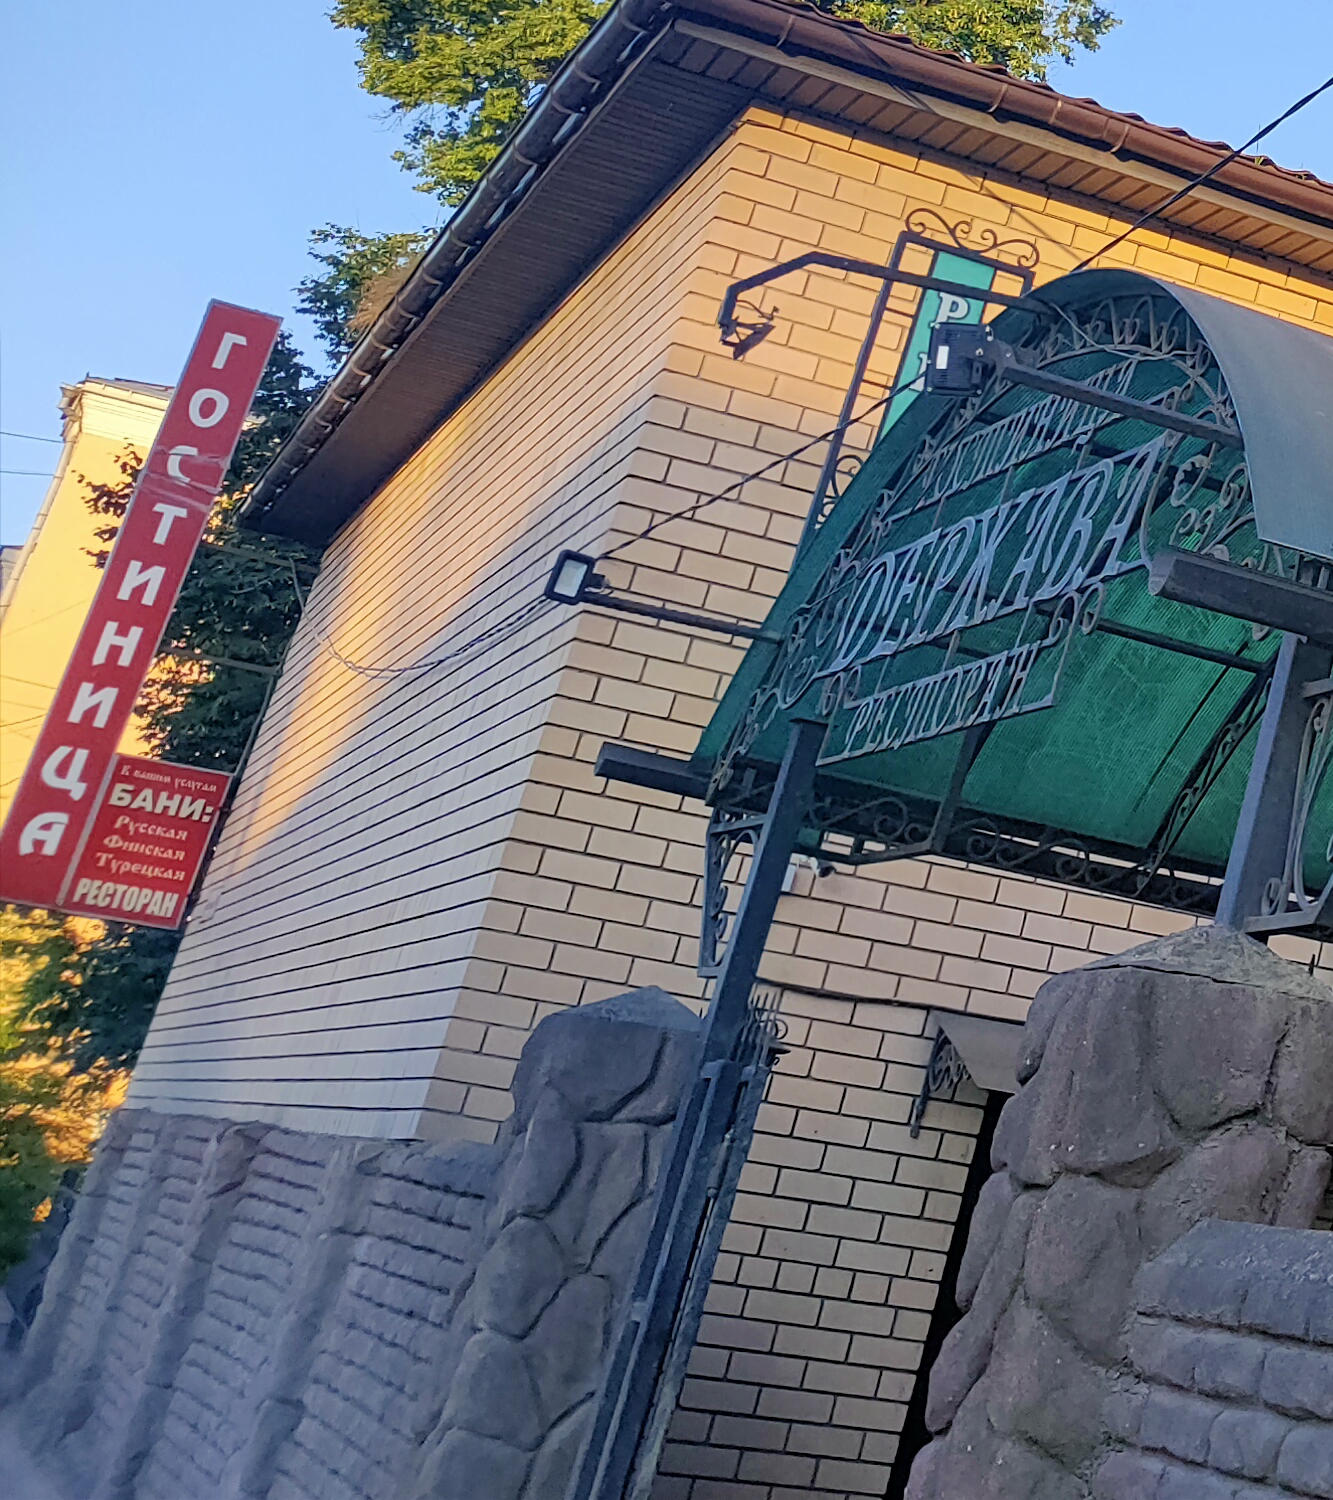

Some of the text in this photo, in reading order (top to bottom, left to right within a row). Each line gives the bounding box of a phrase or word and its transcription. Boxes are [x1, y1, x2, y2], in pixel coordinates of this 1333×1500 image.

[834, 437, 1165, 669] ДЕРЖАВА
[18, 330, 248, 857] ГОСТИНИЦА
[844, 640, 1042, 756] РЕСТОРАН
[109, 783, 214, 823] БАНИ:
[103, 835, 185, 861] Финская
[114, 815, 188, 841] Русская
[96, 852, 186, 881] Турецкая
[73, 878, 179, 918] РЕСТОРАН
